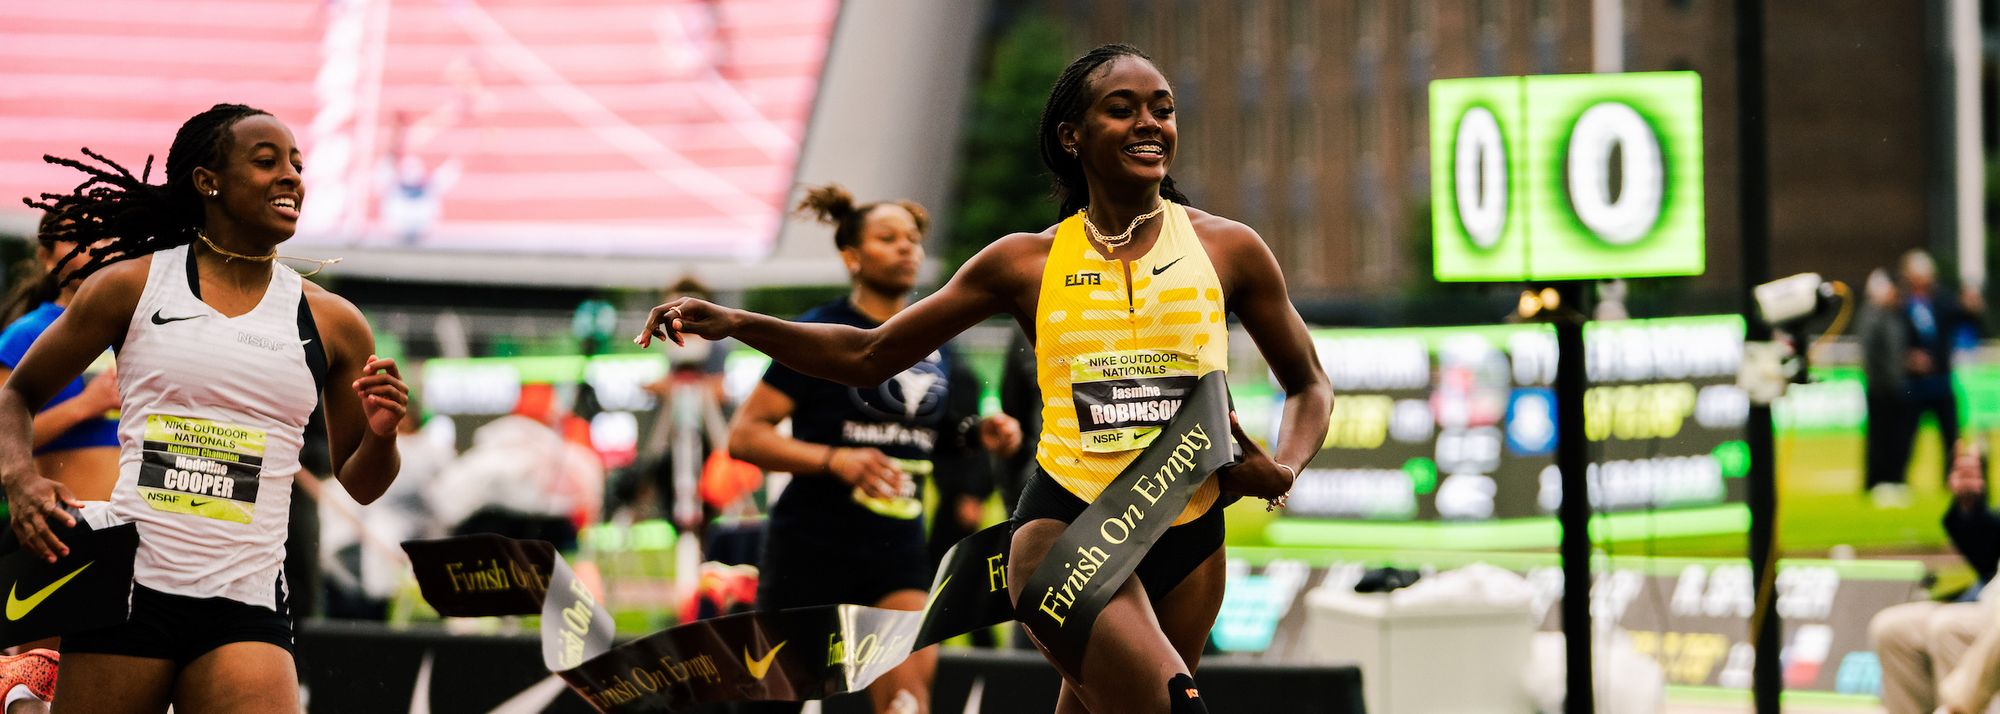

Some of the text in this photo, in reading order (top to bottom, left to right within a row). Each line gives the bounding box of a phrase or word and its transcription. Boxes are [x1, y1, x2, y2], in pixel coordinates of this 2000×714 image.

[1568, 101, 1664, 245] 0
[1089, 353, 1178, 367] NIKE OUTDOOR
[1102, 365, 1167, 377] NATIONALS
[1112, 384, 1161, 400] Jasmine
[164, 420, 248, 440] NIKE OUTDOOR
[1093, 433, 1123, 444] NSAF
[174, 433, 236, 449] NATIONALS
[167, 444, 240, 462] National Champion
[175, 455, 228, 475] Madeline
[163, 469, 235, 498] COOPER
[147, 492, 180, 503] NSAF
[1039, 422, 1212, 628] Finish On Empty
[631, 667, 671, 693] On
